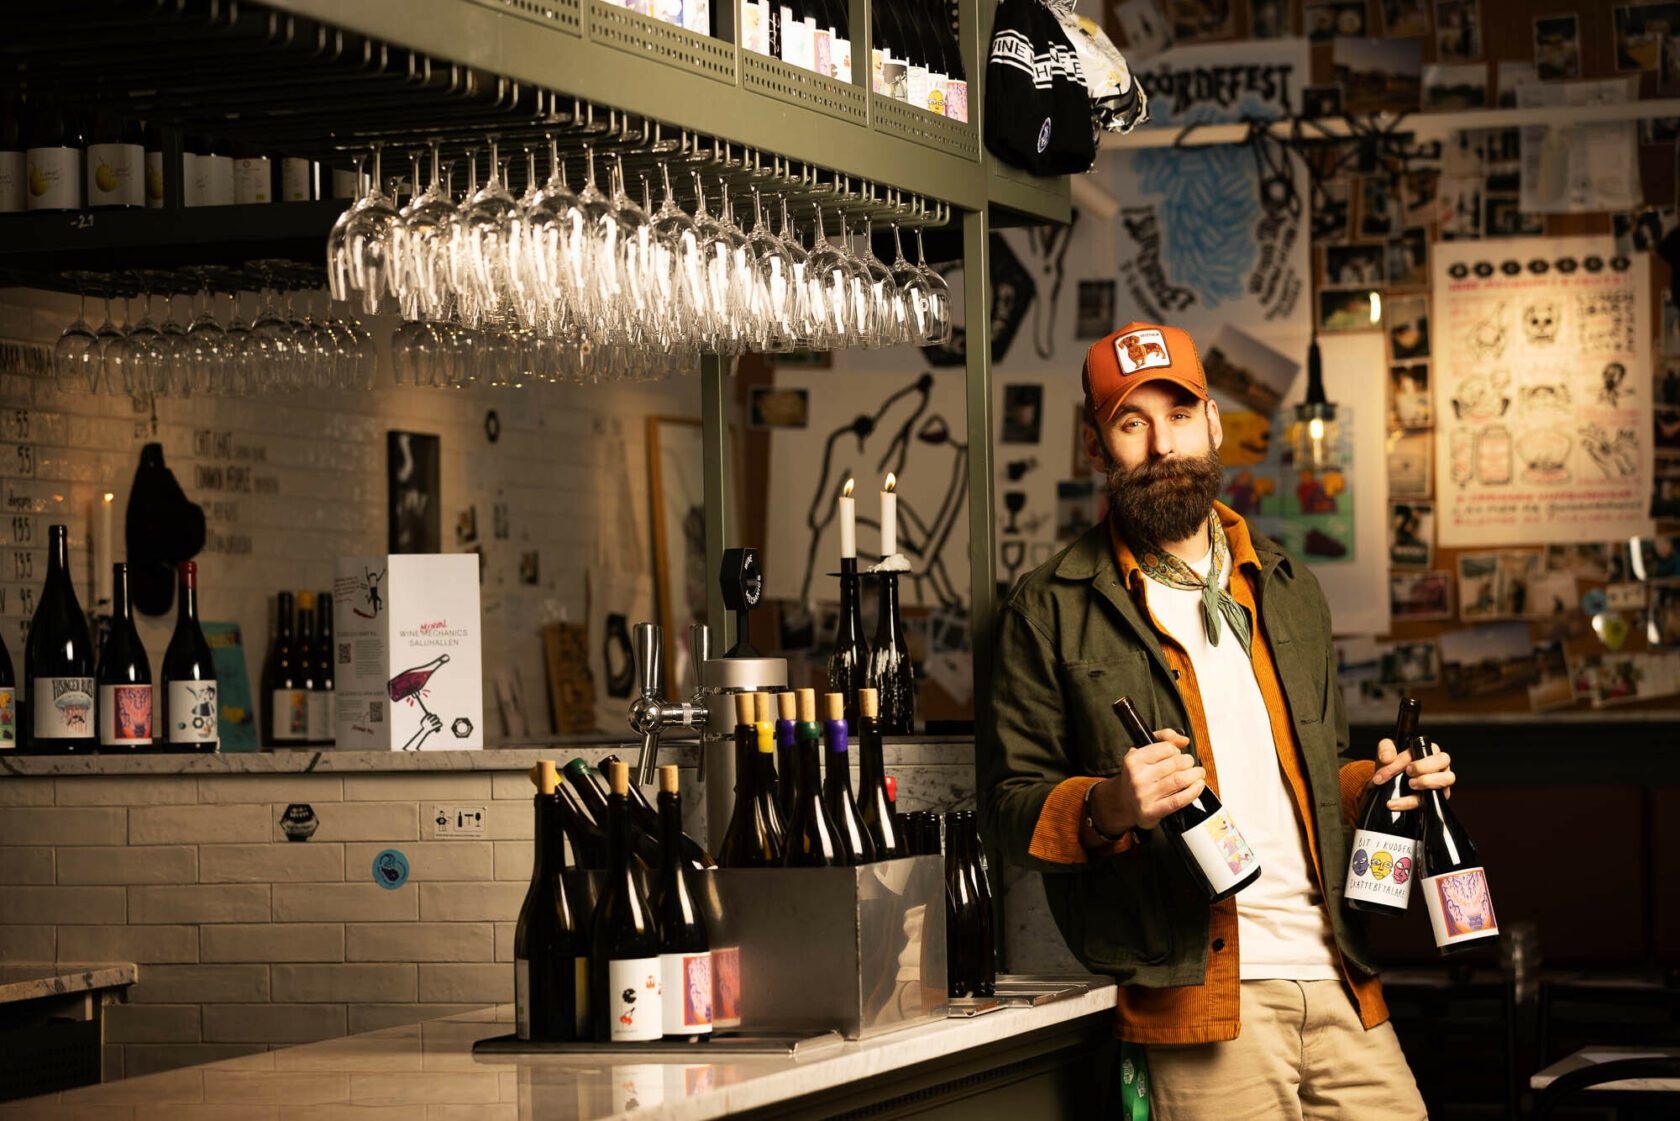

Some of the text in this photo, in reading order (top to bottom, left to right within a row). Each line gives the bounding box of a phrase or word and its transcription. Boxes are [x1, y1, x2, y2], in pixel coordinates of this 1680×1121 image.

[400, 630, 419, 638] WINE
[409, 639, 460, 648] SALUHALLEN
[1358, 838, 1371, 848] BIT
